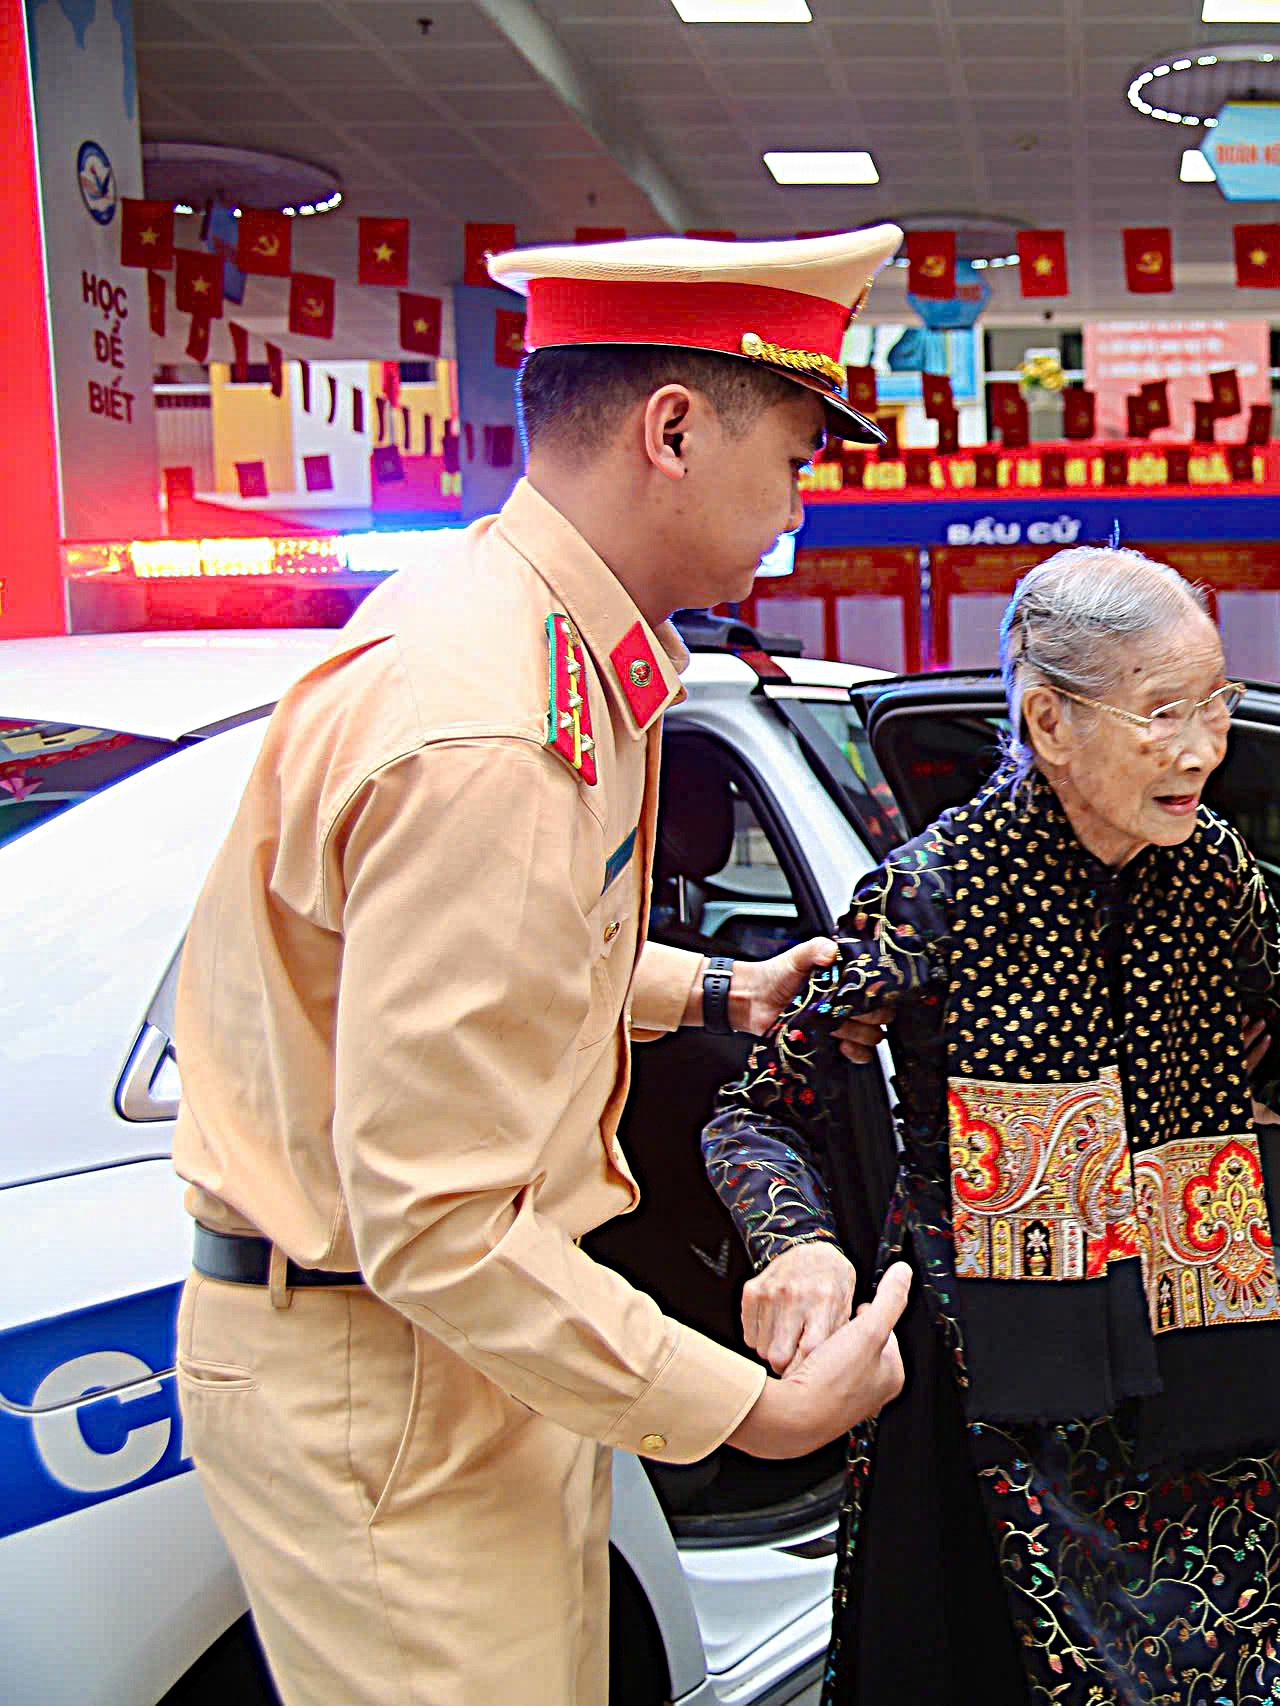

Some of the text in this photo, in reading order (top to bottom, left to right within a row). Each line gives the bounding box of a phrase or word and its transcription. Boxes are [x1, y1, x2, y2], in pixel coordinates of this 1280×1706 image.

[82, 269, 128, 319] HỌC
[88, 375, 134, 424] BIẾT
[1026, 514, 1082, 544] CỬ
